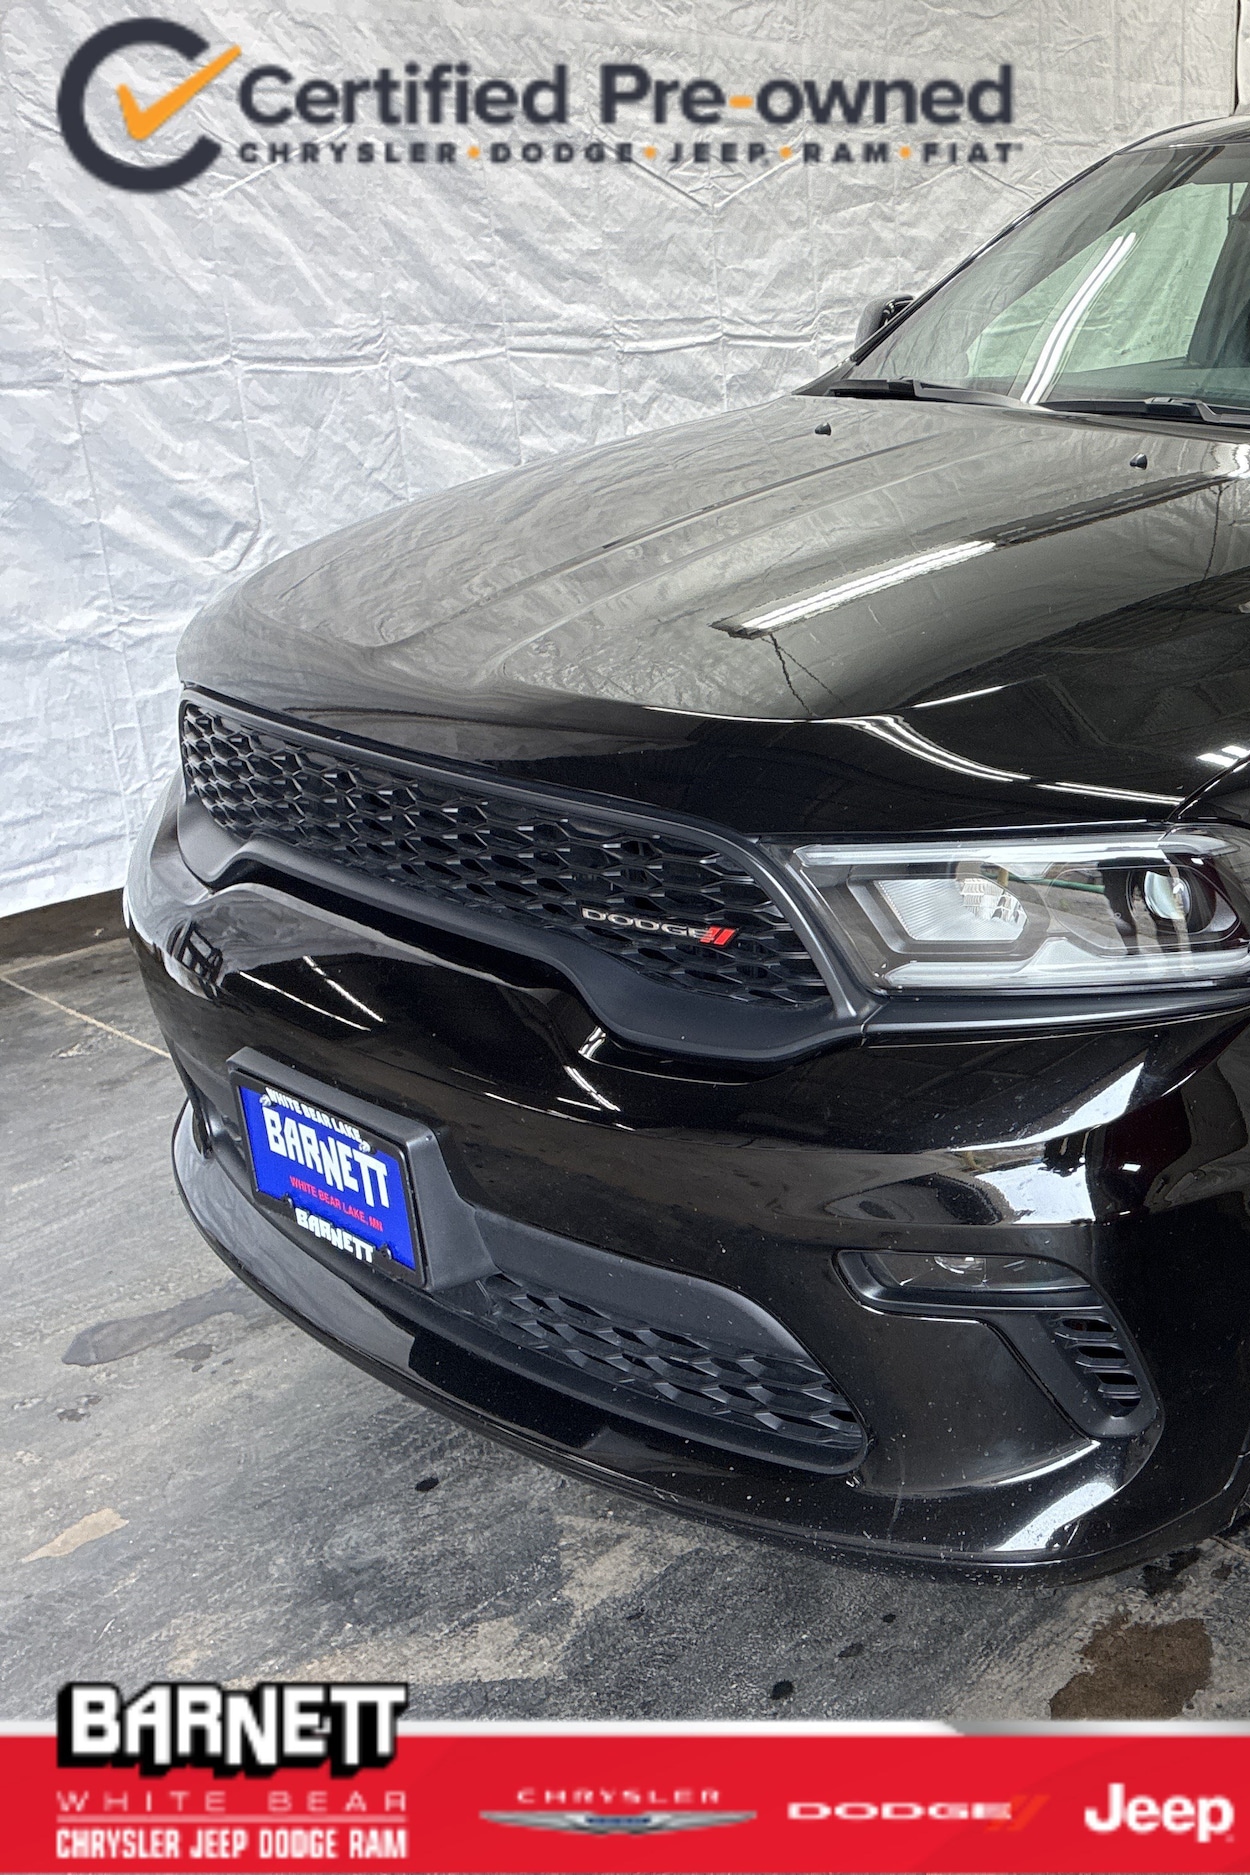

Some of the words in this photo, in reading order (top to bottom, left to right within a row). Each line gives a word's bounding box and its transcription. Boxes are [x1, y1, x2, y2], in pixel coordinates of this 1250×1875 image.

[582, 907, 715, 942] DODGE
[265, 1087, 302, 1112] WHITE
[301, 1106, 333, 1127] BEAR
[332, 1119, 361, 1141] LAKE
[262, 1106, 390, 1209] BARNETT
[289, 1175, 318, 1198] WHITE
[318, 1189, 343, 1210] BEAR
[369, 1214, 384, 1233] MN
[295, 1207, 374, 1263] BARNETT
